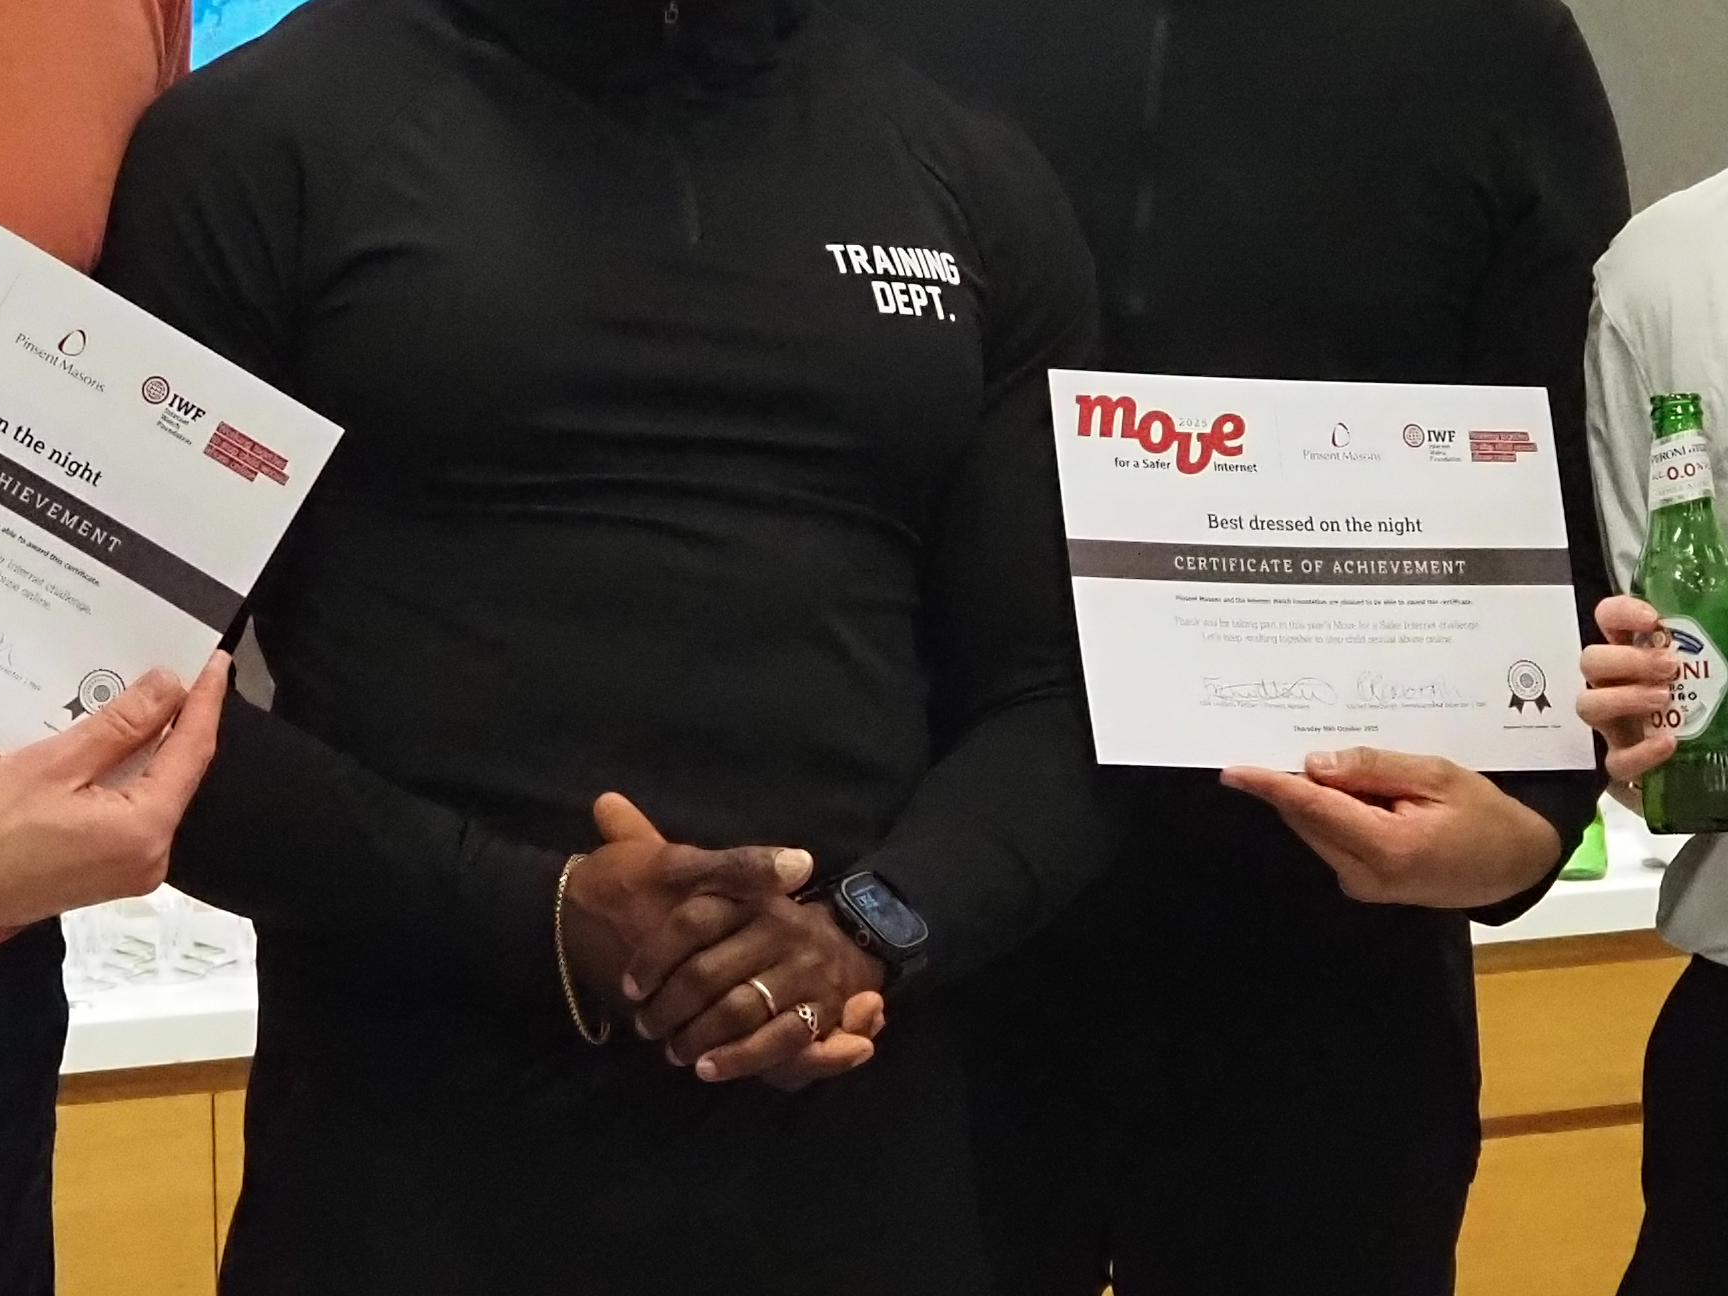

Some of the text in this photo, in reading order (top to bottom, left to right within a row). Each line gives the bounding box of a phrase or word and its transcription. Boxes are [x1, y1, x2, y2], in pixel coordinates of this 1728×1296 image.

[825, 244, 960, 286] TRAINING
[871, 280, 956, 322] DEPT.
[14, 332, 105, 392] Pinsent Masons
[167, 393, 206, 421] IWF
[1076, 394, 1245, 475] move
[1426, 429, 1455, 442] IWF
[12, 425, 45, 454] the
[47, 448, 101, 486] night
[1113, 456, 1257, 472] for a Safer Internet
[1207, 513, 1422, 536] Best dressed on the night
[1173, 555, 1465, 574] CERTIFICATE OF ACHIEVEMENT
